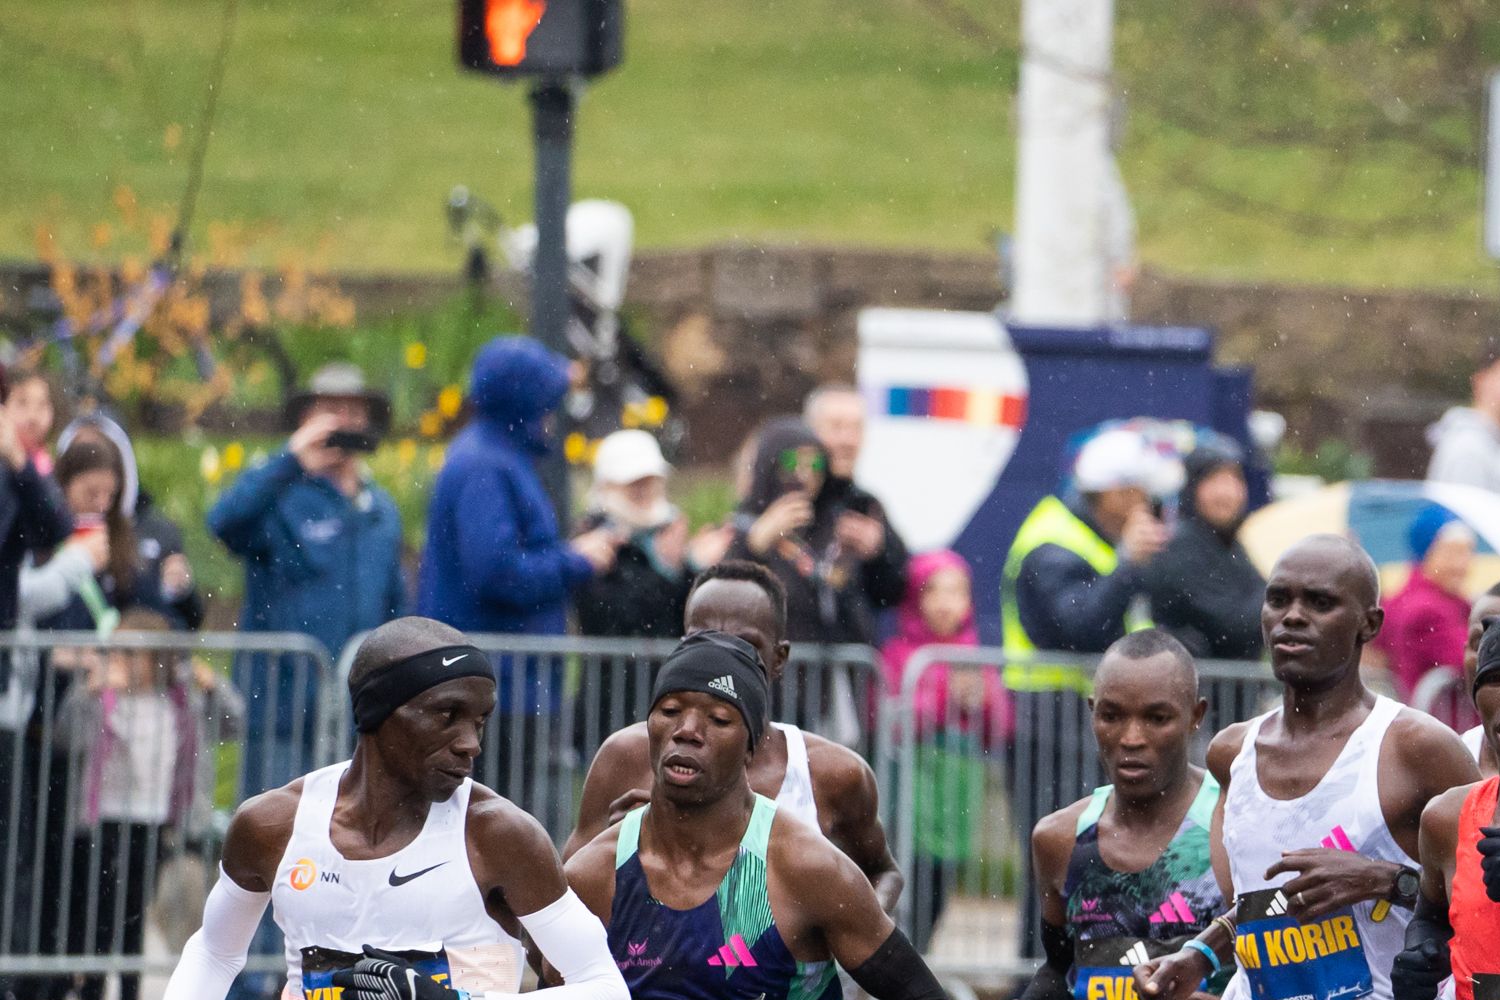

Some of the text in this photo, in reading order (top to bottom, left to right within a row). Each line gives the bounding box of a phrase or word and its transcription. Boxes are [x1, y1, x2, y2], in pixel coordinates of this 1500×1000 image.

[707, 681, 738, 699] adidas
[320, 871, 340, 884] NN
[1263, 915, 1361, 968] KORIR
